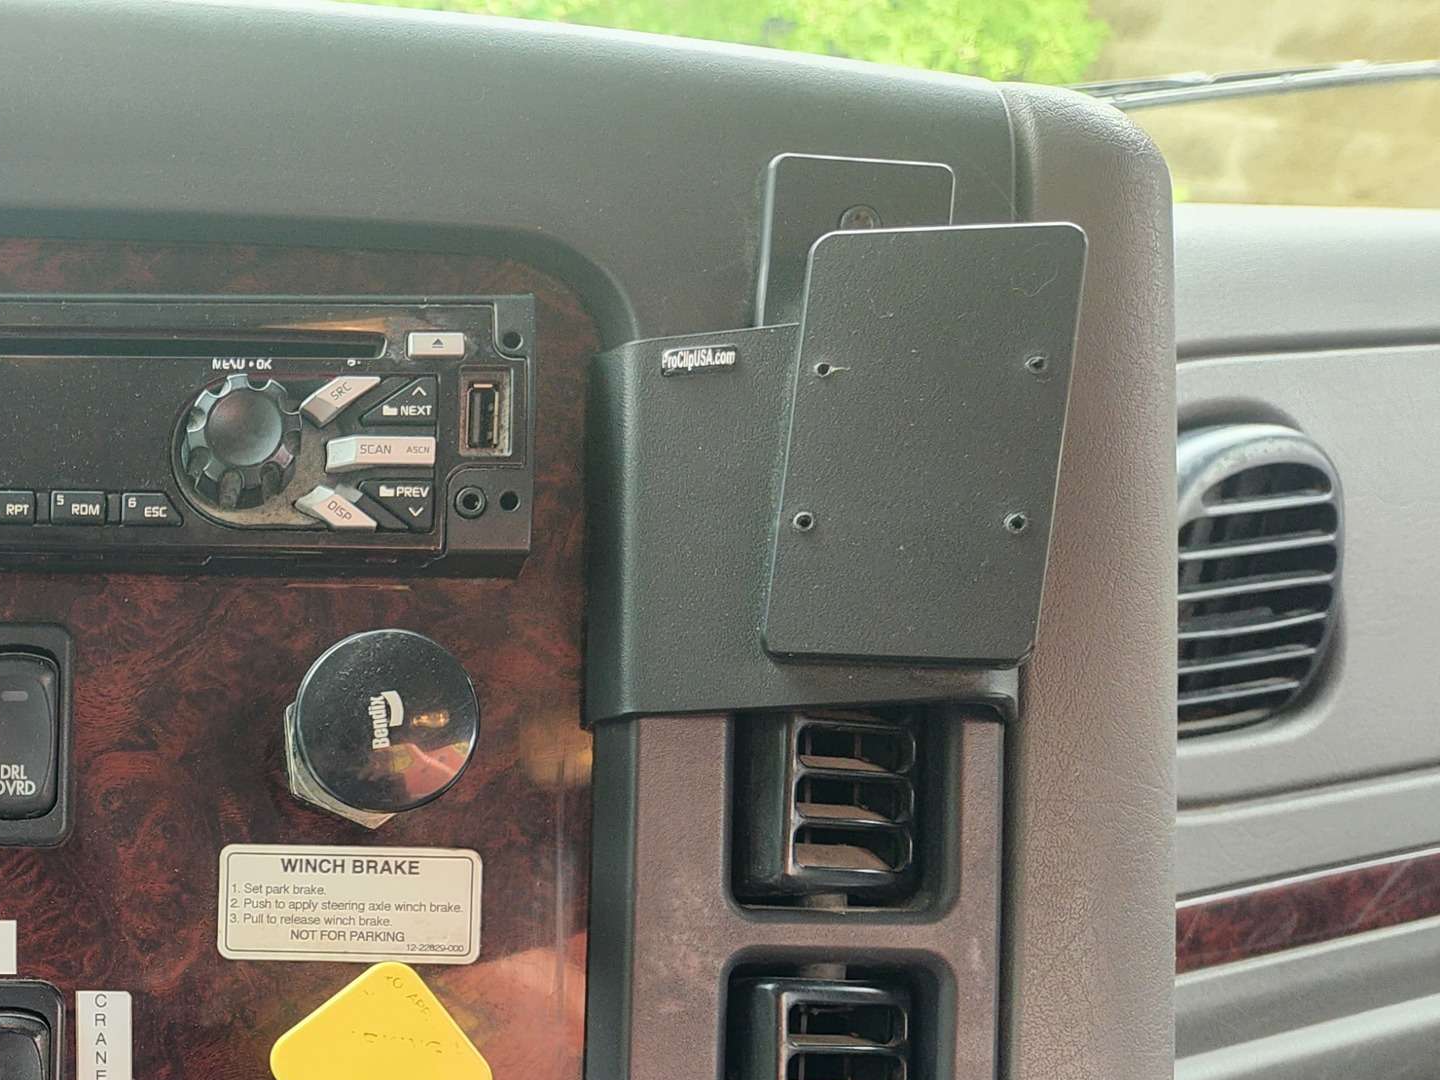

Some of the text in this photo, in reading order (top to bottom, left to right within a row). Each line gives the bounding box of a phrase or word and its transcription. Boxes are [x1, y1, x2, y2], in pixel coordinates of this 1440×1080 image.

[661, 348, 736, 371] ProClipUSA.com
[330, 381, 352, 400] SRC
[400, 405, 432, 416] NEXT
[360, 444, 392, 455] SCAN
[396, 487, 430, 498] PREV
[56, 494, 65, 506] 5
[127, 497, 137, 508] 6
[6, 503, 30, 516] RPT
[71, 503, 100, 516] RDM
[144, 506, 168, 518] ESC
[327, 500, 353, 521] DISP
[368, 695, 391, 750] Bendix
[0, 764, 28, 780] DRL
[280, 858, 420, 876] WINCH BRAKE
[244, 883, 263, 895] Set
[265, 884, 290, 896] park
[292, 885, 327, 896] brake.
[243, 898, 272, 909] Push
[275, 899, 286, 910] to
[288, 900, 318, 913] apply
[321, 901, 365, 913] steering
[368, 902, 391, 912] axle
[394, 903, 427, 912] winch
[429, 902, 464, 913] brake.
[243, 913, 264, 924] Pull
[266, 914, 277, 925] to
[280, 914, 321, 926] release
[323, 915, 356, 926] winch
[358, 915, 393, 927] brake.
[290, 929, 405, 942] NOT FOR PARKING
